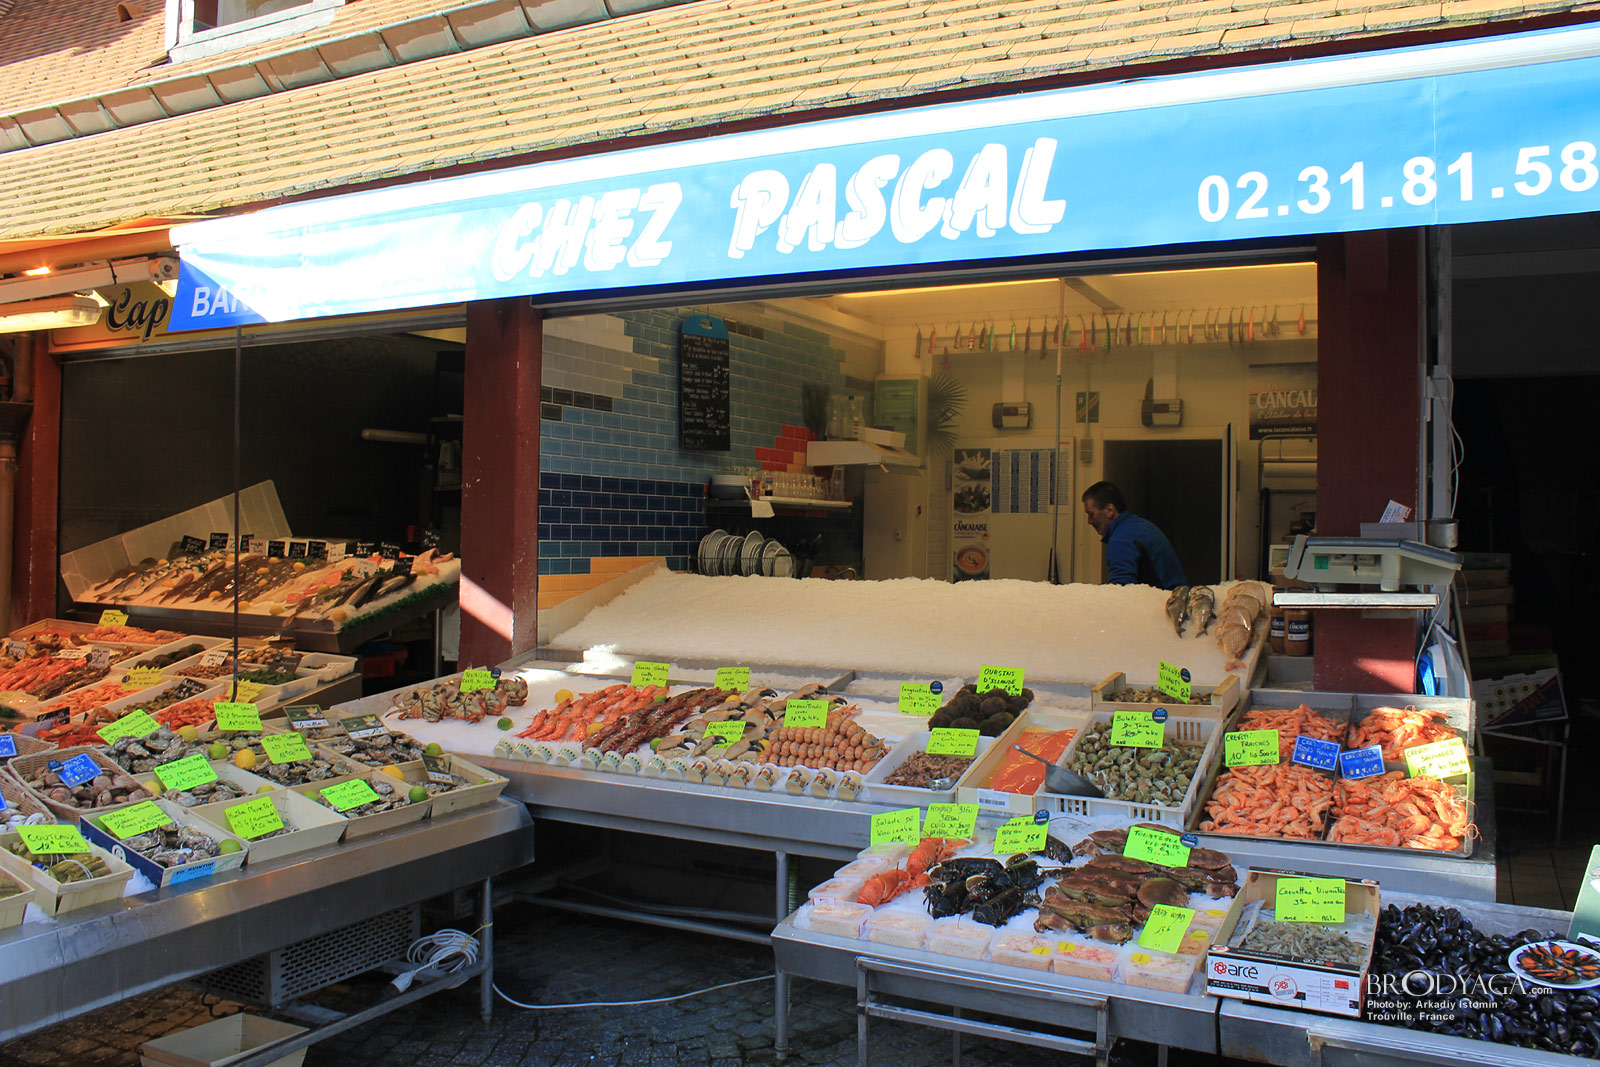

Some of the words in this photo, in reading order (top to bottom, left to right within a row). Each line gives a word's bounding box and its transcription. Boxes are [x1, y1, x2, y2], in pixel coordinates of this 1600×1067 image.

[1198, 141, 1599, 223] 02.31.81.58
[492, 181, 682, 282] CHEZ
[728, 137, 1066, 259] PASCAL
[984, 668, 1016, 677] OURSINS
[1024, 833, 1041, 843] 25€
